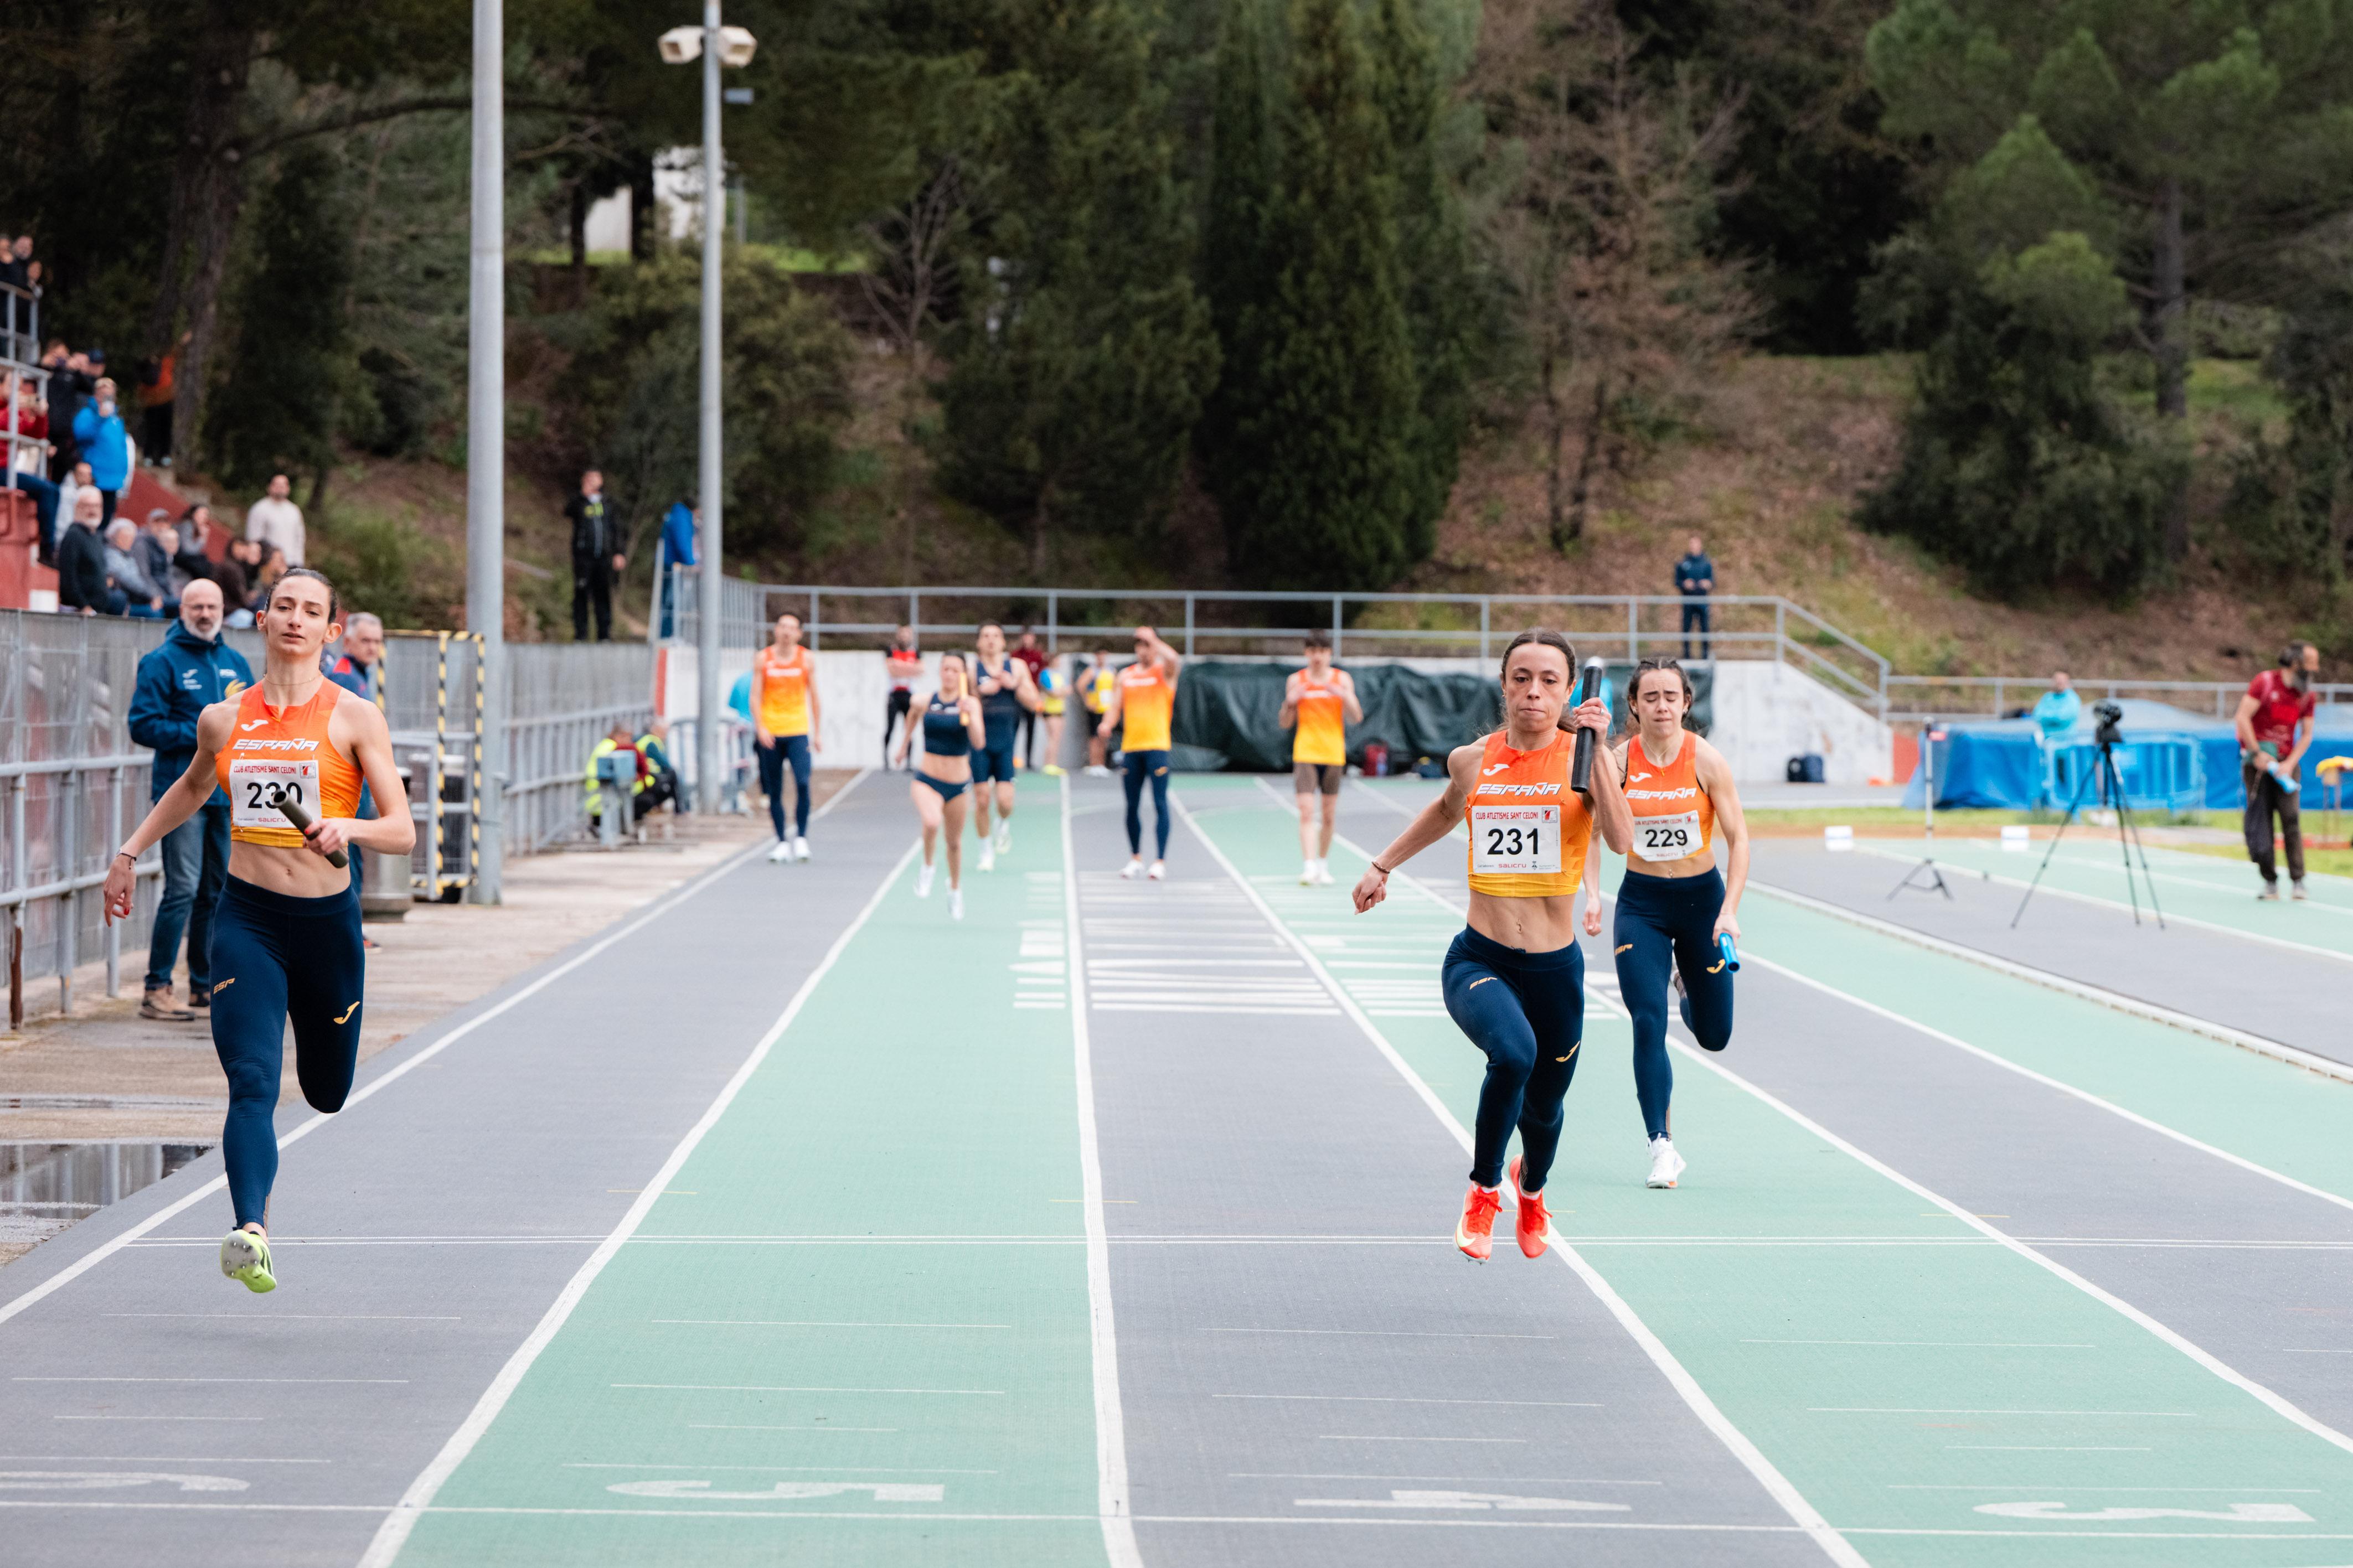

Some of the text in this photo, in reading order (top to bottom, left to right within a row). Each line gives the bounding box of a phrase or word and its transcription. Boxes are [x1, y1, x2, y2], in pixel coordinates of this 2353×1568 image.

[232, 738, 319, 751] ESPAÑA
[1475, 782, 1562, 796] ESPAÑA
[1626, 788, 1697, 800] ESPAÑA
[1487, 828, 1538, 855] 231
[1645, 829, 1688, 847] 229
[606, 1480, 945, 1502] 5
